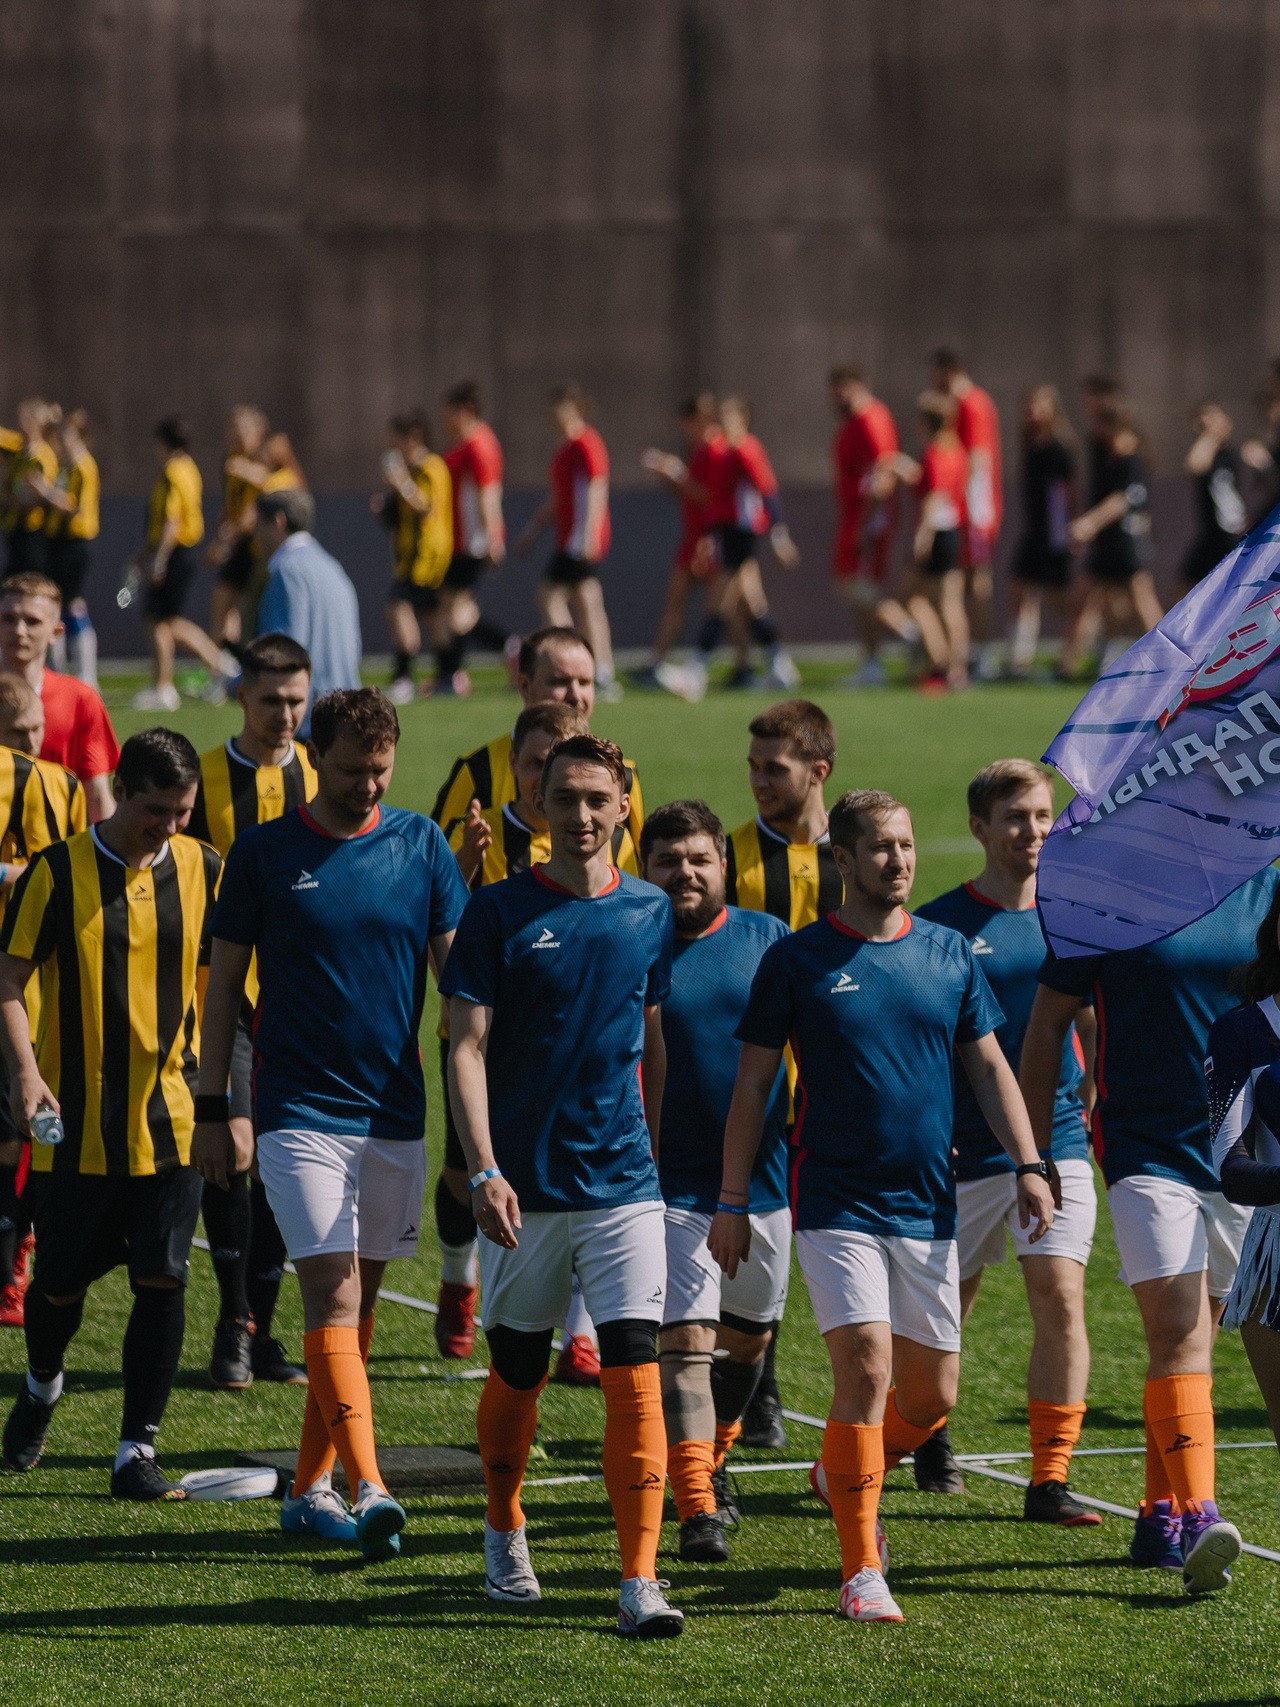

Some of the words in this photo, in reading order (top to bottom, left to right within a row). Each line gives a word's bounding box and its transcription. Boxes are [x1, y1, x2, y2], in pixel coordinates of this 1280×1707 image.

[531, 941, 561, 949] DEMIX
[830, 984, 860, 994] DEMIX
[1164, 1442, 1204, 1454] DEMIX
